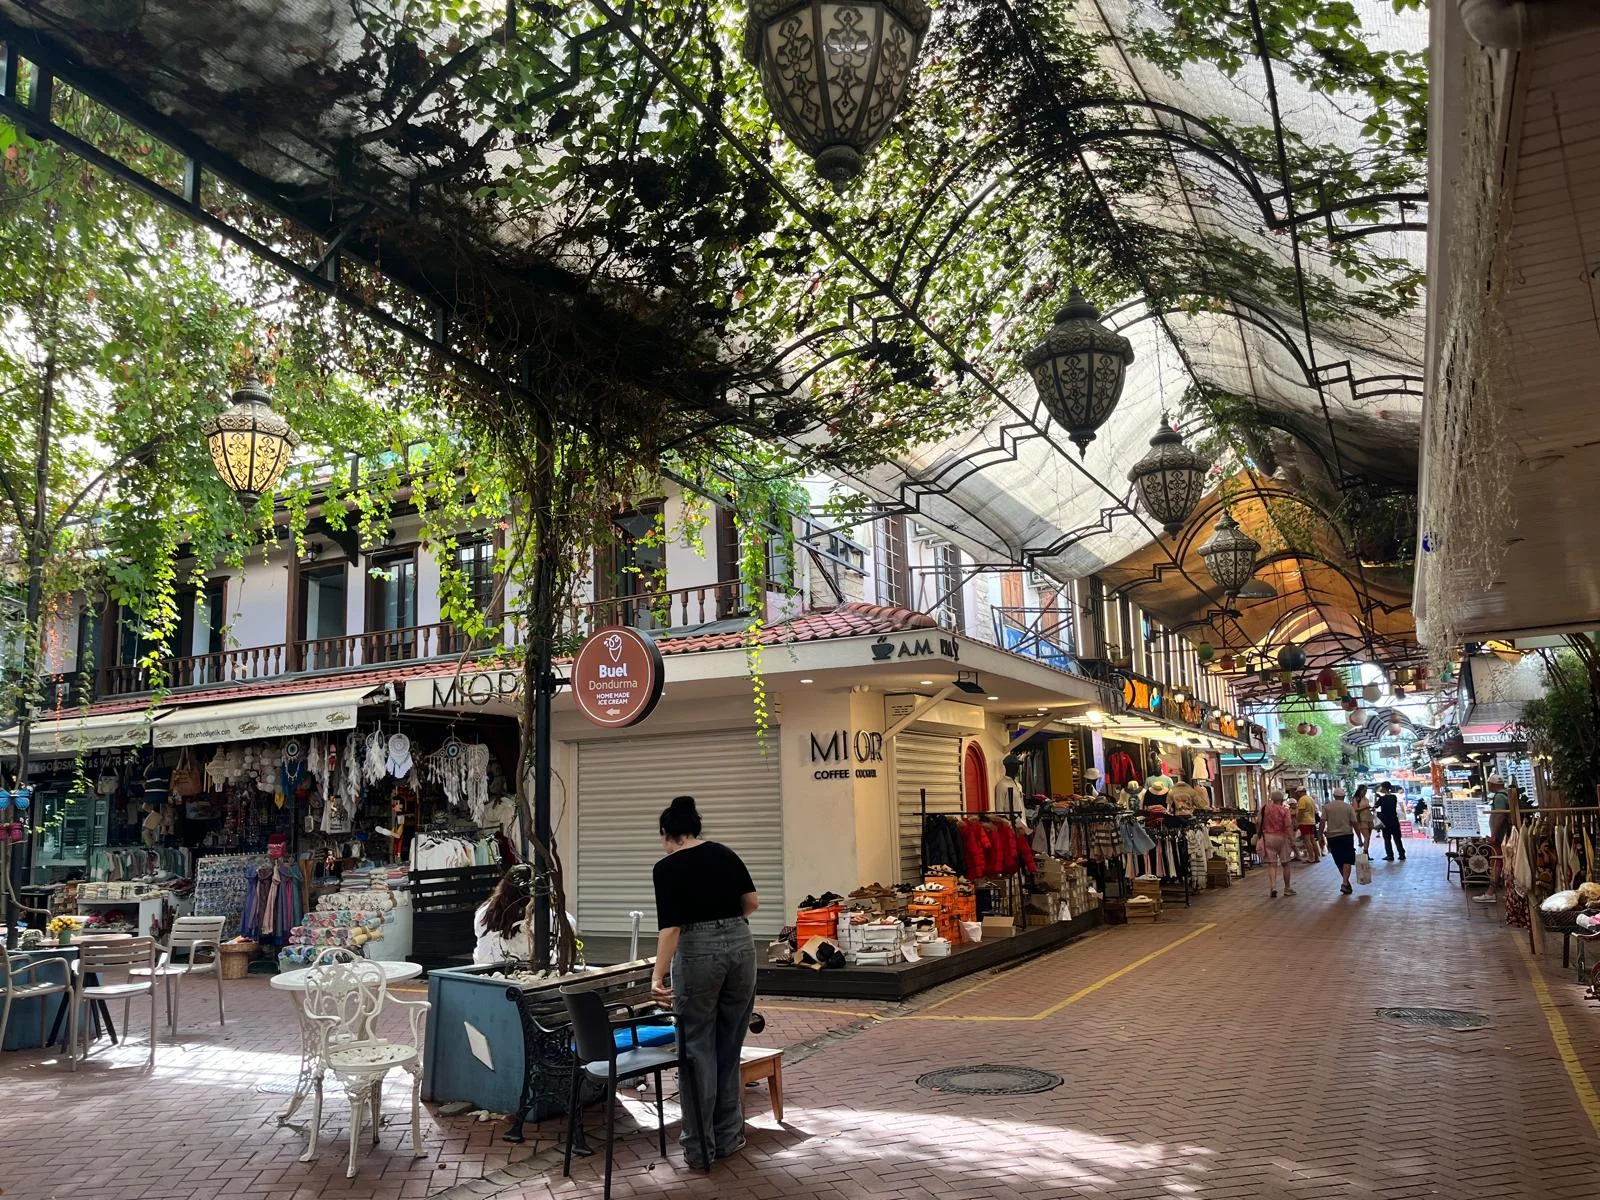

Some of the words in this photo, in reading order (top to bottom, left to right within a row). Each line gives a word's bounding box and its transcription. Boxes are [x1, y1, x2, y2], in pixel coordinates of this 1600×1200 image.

[897, 638, 934, 657] A.M.
[599, 663, 628, 678] Buel
[588, 680, 638, 690] Dondurma
[596, 692, 613, 700] HOME
[810, 730, 883, 763] MIOR
[814, 769, 850, 780] COFFEE
